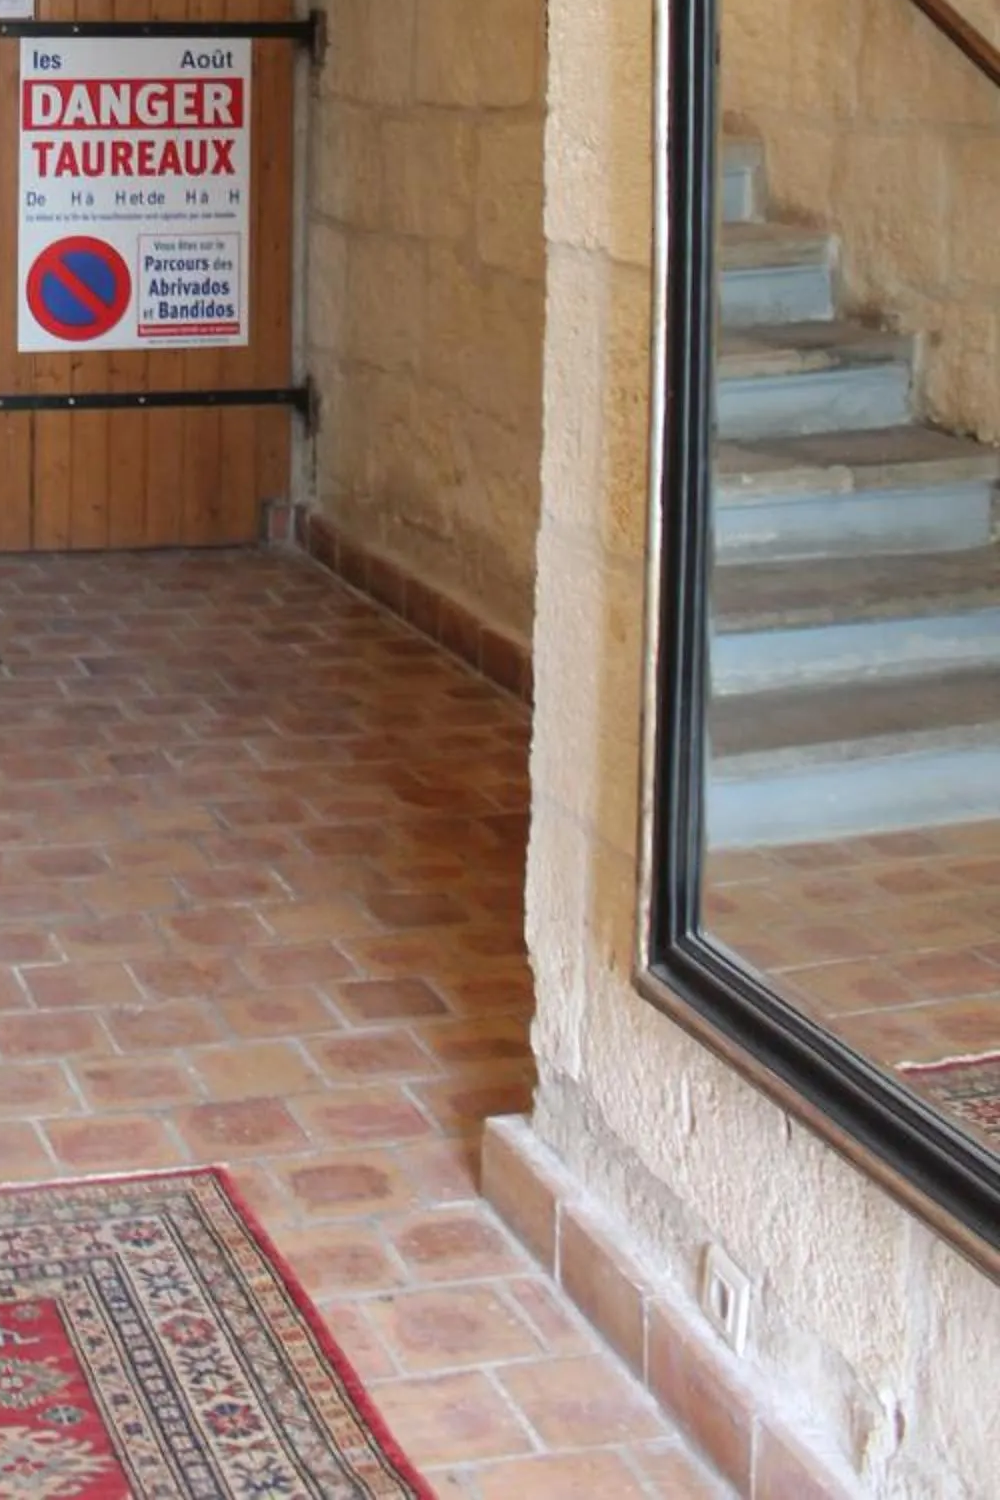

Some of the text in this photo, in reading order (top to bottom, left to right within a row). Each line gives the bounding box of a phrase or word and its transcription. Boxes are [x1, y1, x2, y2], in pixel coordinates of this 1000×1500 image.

[33, 49, 234, 70] les Août
[31, 83, 235, 126] DANGER
[32, 139, 236, 177] TAUREAUX
[71, 190, 82, 206] H
[115, 190, 126, 206] H
[185, 188, 197, 204] H
[229, 188, 240, 204] H
[144, 255, 233, 272] Parcours des
[149, 277, 230, 296] Abrivados
[158, 299, 235, 319] Bandidos
